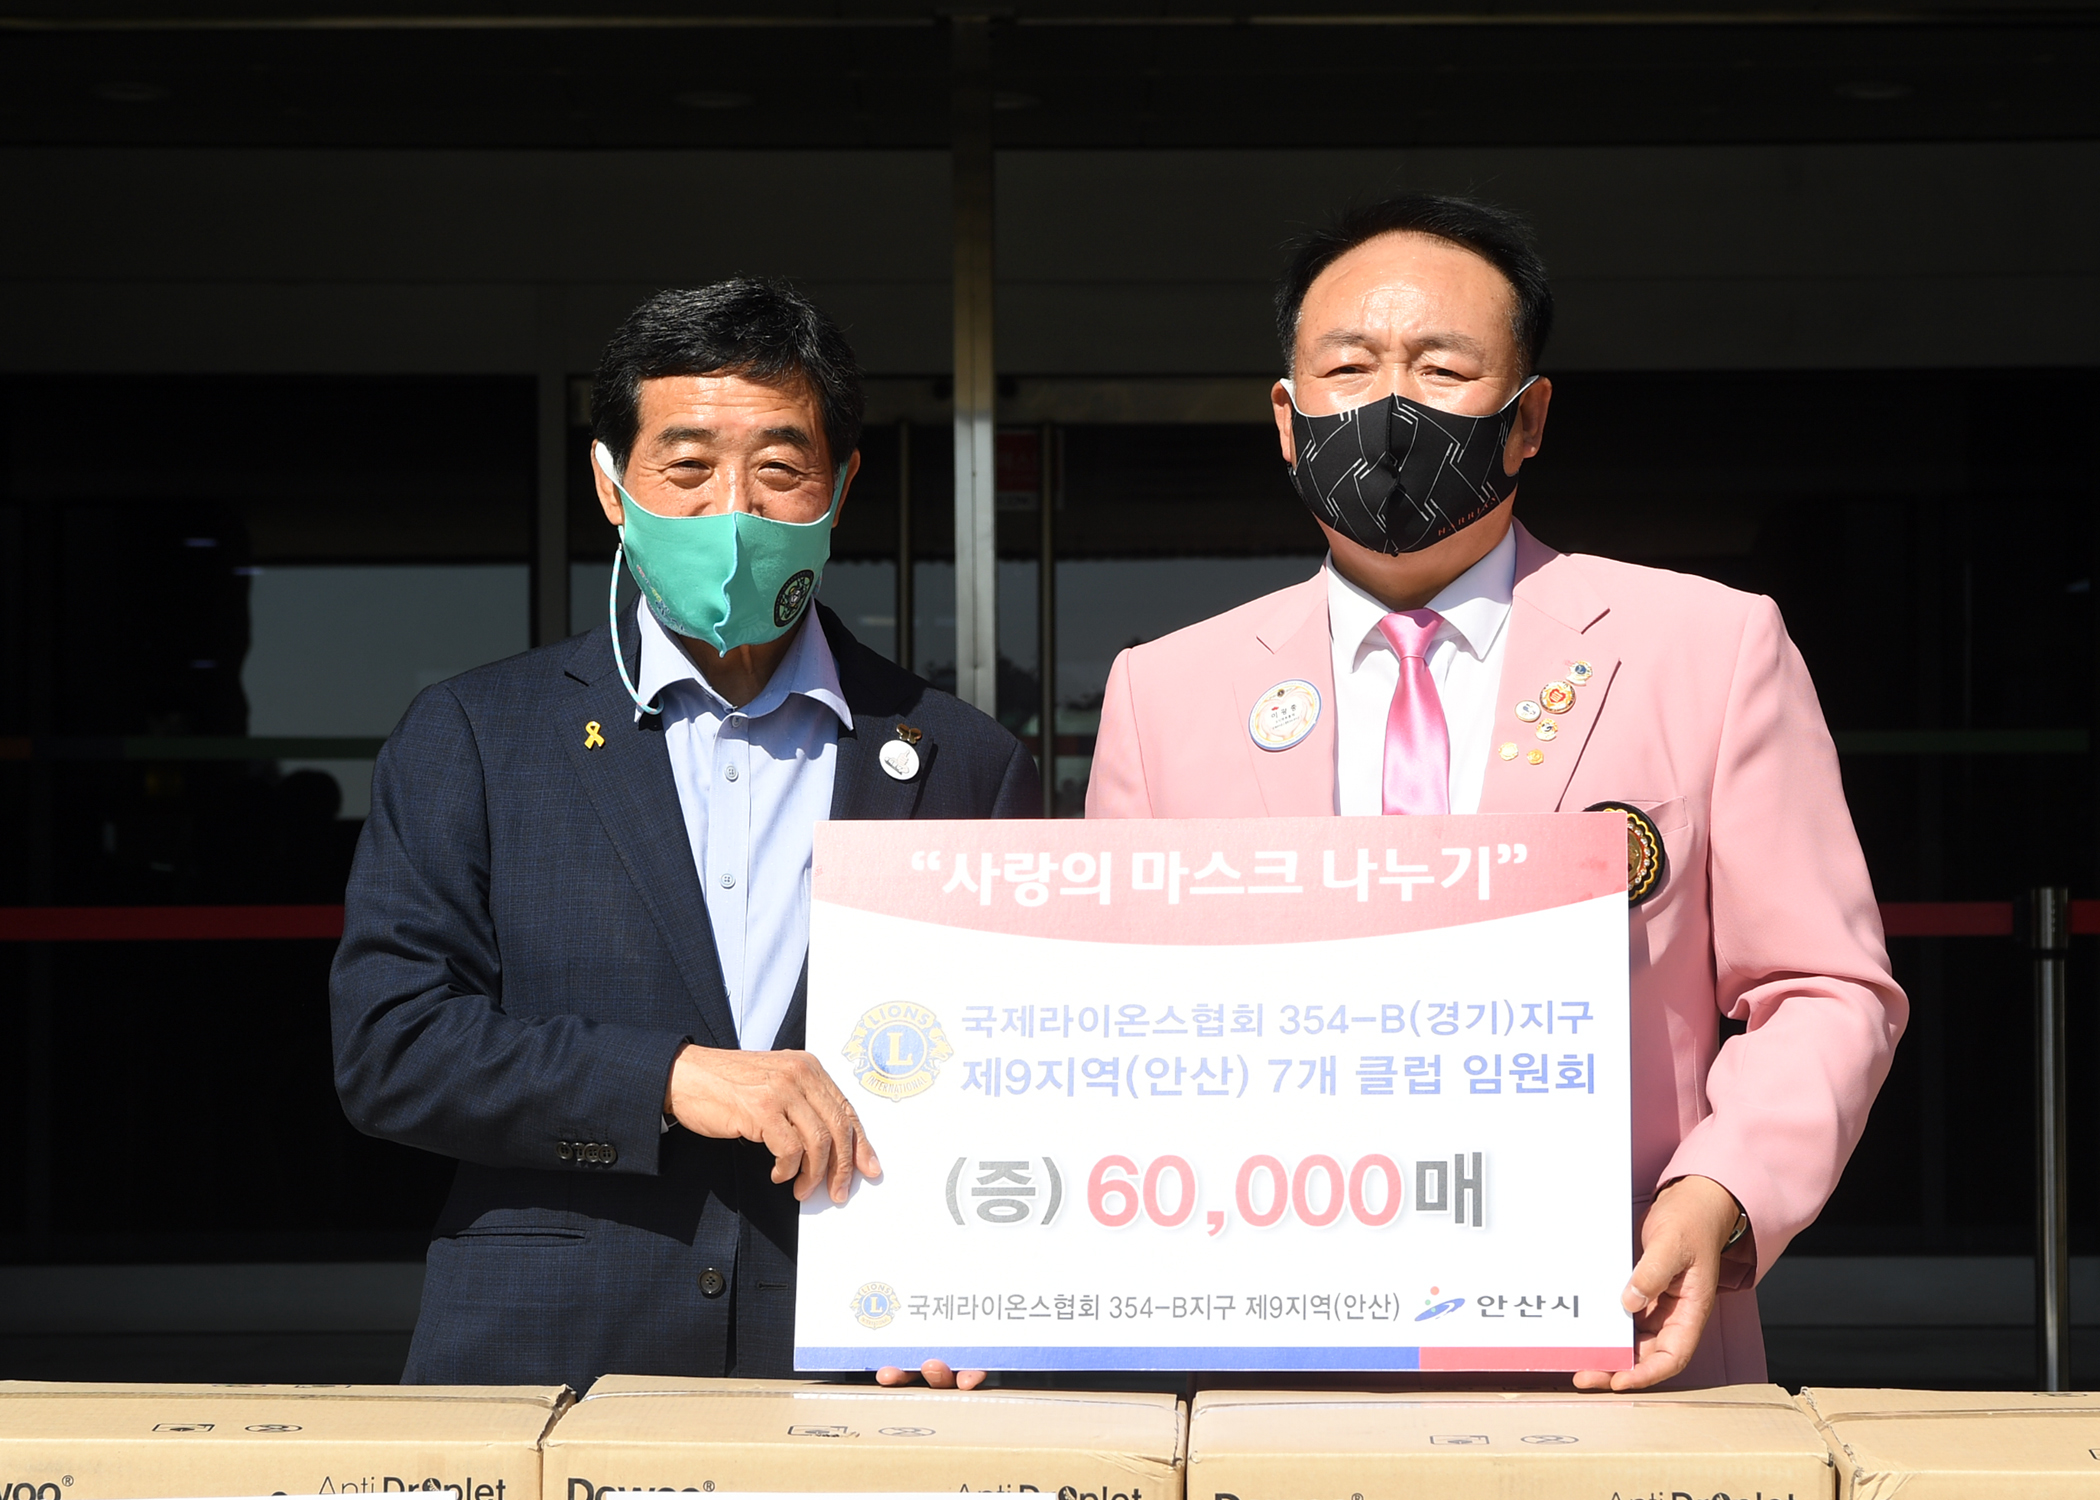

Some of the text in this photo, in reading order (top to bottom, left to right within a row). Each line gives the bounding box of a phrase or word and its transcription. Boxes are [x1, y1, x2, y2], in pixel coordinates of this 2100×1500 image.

[1131, 850, 1304, 905] 마스크
[867, 1005, 931, 1026] LIONS
[963, 1003, 1262, 1038] 국제라이온스협회
[886, 1031, 914, 1066] L
[865, 1076, 929, 1094] INTERNATIONAL
[962, 1052, 1595, 1099] 제9지역(안산) 7개 클럽 임원회
[945, 1156, 1063, 1226] (증)
[861, 1283, 891, 1294] LIONS
[907, 1292, 1400, 1322] 국제라이온스협회 354-B지구 제9지역(안산)
[1476, 1294, 1580, 1319] 안산시
